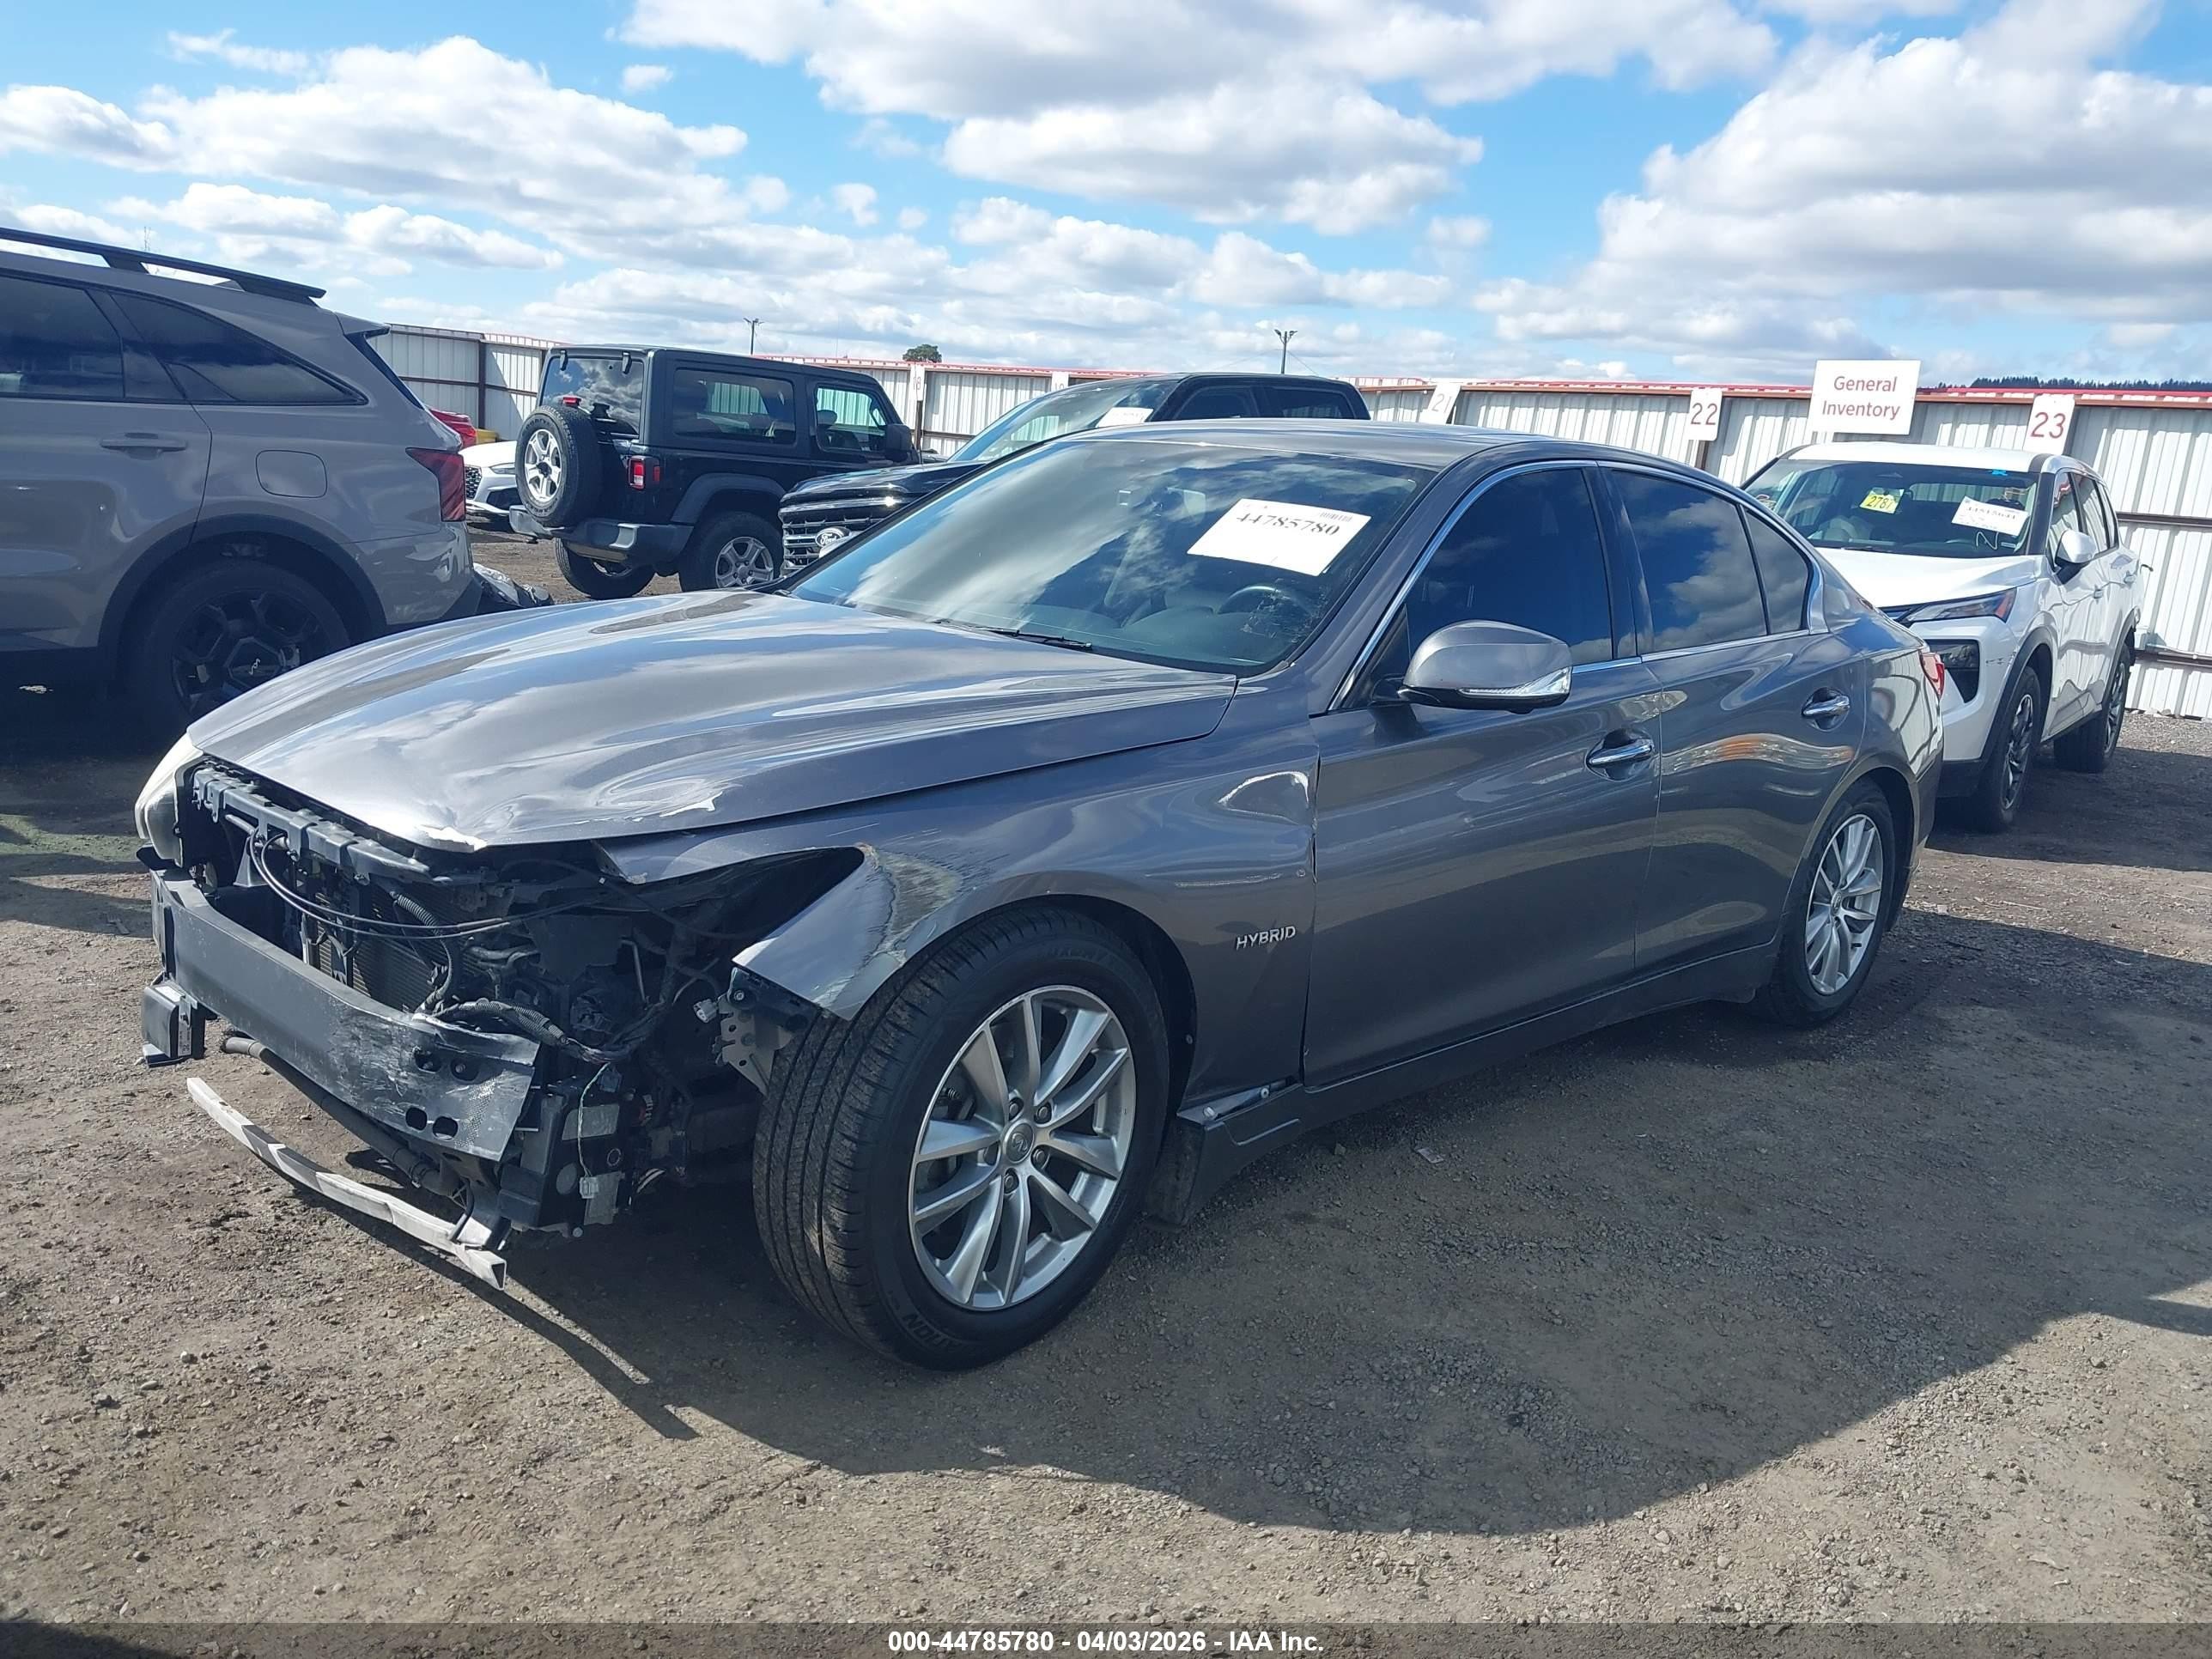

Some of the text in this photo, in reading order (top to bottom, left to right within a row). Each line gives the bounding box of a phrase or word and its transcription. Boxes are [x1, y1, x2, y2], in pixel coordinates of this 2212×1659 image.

[1833, 375, 1898, 392] General
[1431, 393, 1453, 413] 21
[1691, 402, 1718, 425] 22
[1821, 400, 1901, 421] Inventory
[2031, 411, 2066, 439] 23
[1236, 512, 1340, 536] 44785780
[1236, 926, 1297, 951] HYBRID
